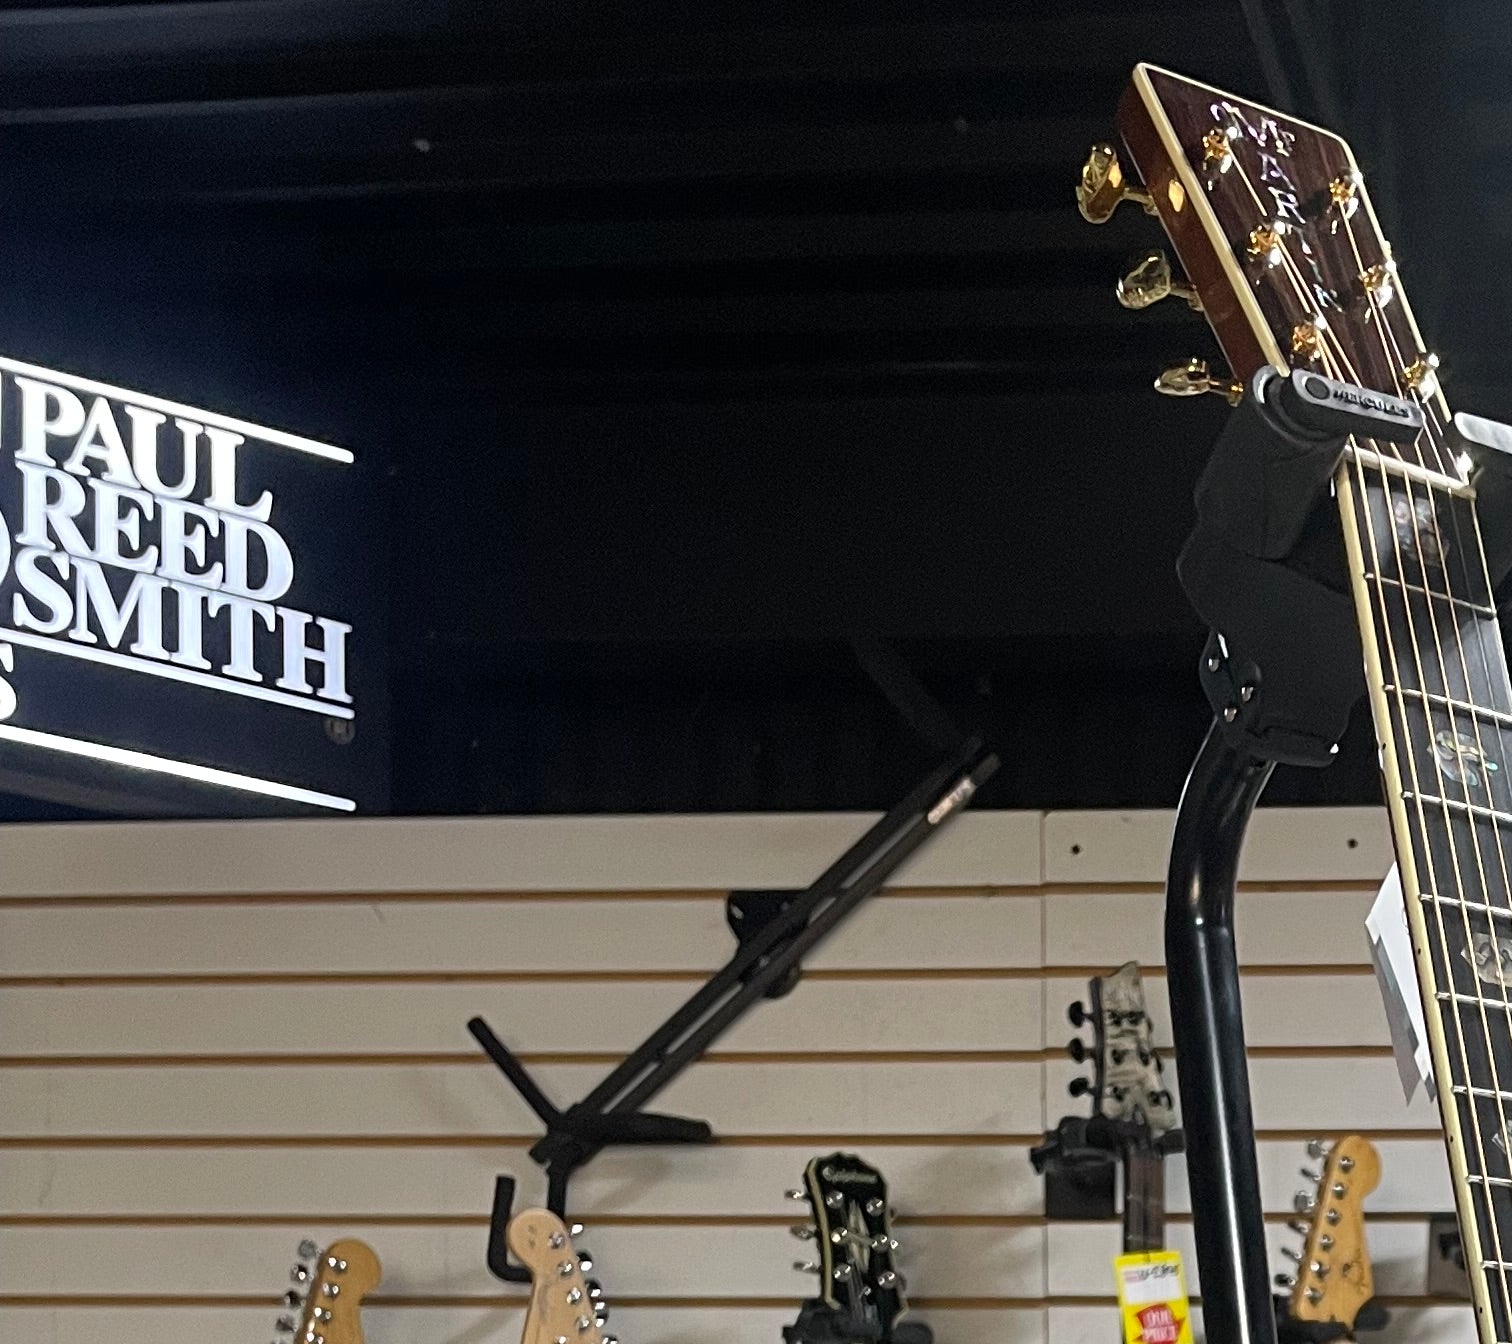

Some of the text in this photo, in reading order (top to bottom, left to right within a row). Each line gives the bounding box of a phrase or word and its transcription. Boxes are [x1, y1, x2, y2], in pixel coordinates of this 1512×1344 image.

[14, 376, 273, 523] PAUL
[14, 459, 294, 603] REED
[13, 545, 354, 703] SMITH
